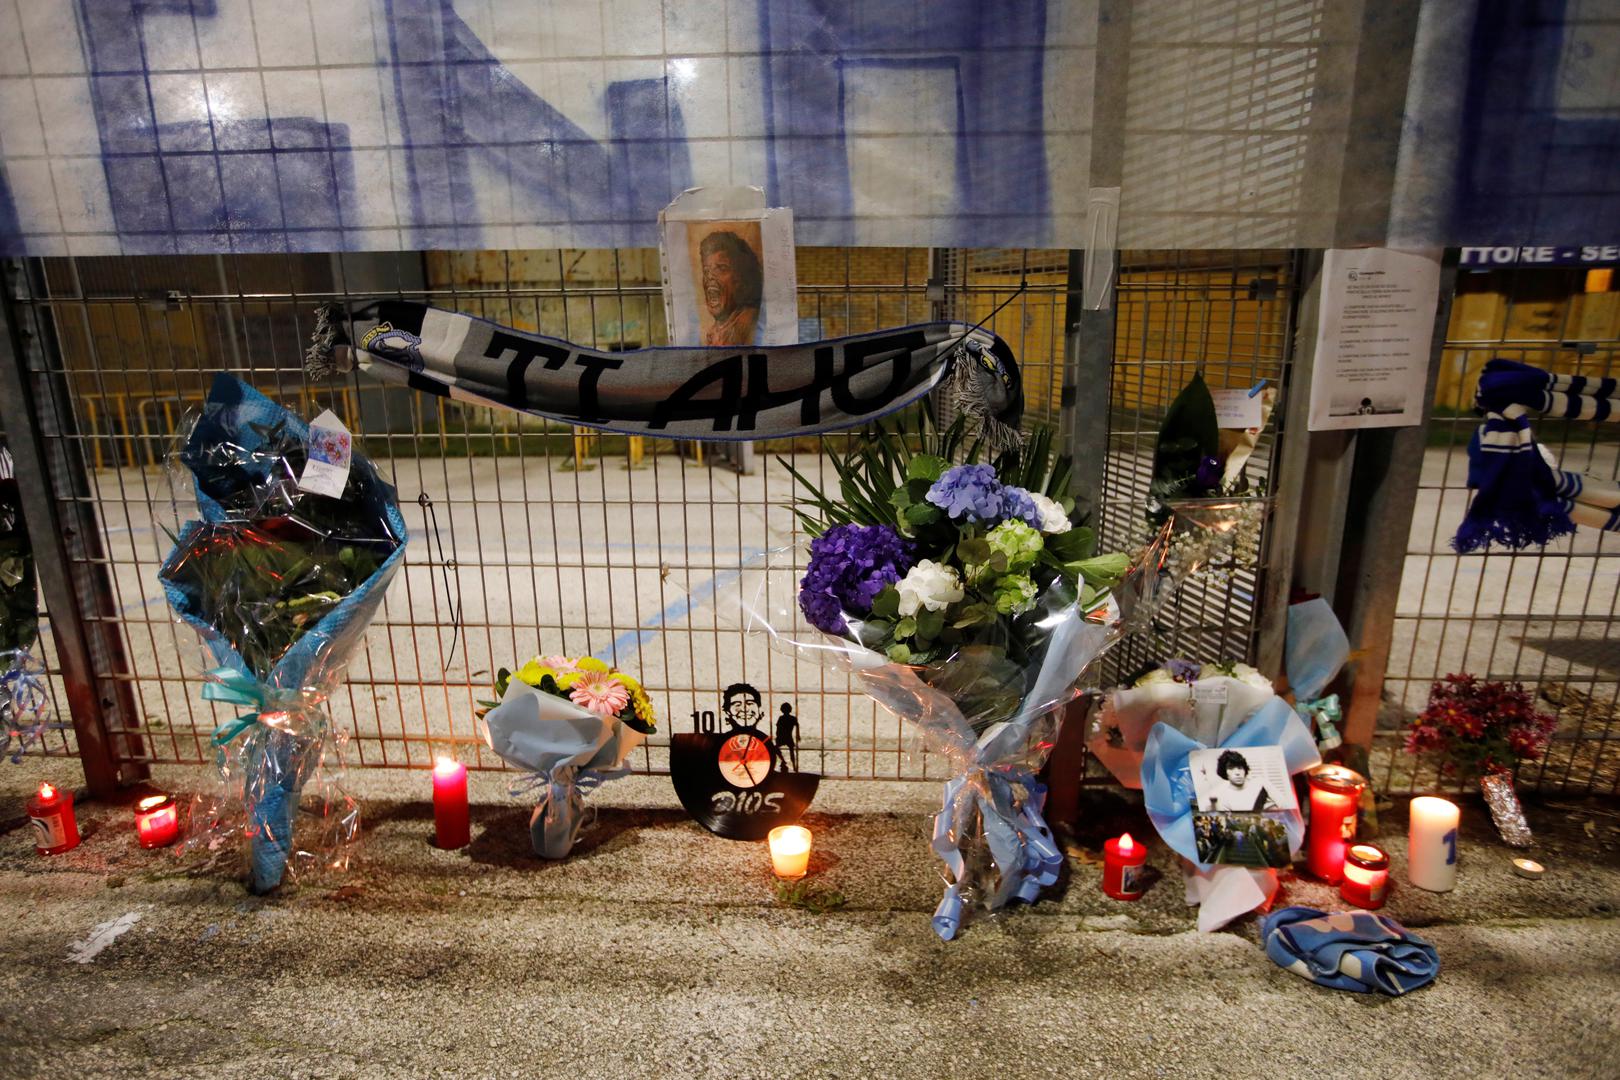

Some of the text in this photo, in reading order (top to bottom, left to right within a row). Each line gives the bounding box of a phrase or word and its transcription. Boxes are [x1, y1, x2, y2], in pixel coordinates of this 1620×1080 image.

[484, 330, 624, 424] TI
[690, 711, 715, 734] 10
[711, 790, 785, 814] DIOS
